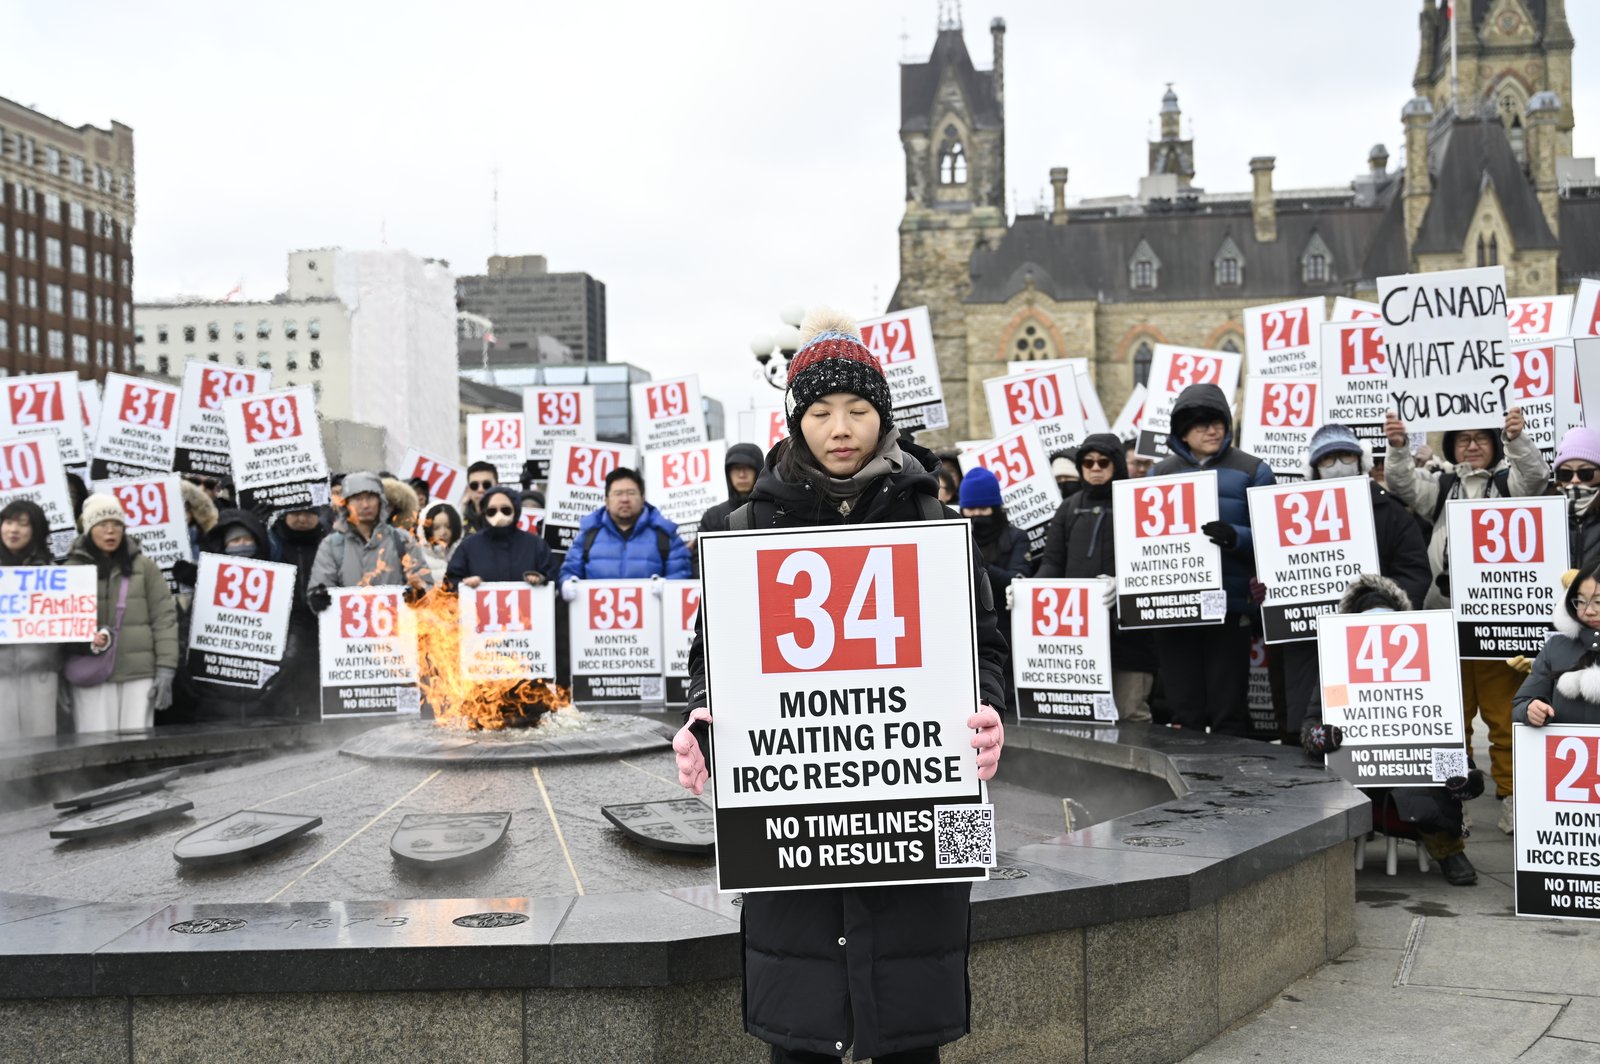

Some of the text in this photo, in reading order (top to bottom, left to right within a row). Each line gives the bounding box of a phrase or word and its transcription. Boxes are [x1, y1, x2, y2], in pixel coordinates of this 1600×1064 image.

[1382, 284, 1508, 326] CANADA
[1266, 311, 1304, 350] 27
[870, 321, 911, 365] 42
[1268, 352, 1306, 363] MONTHS
[1386, 340, 1505, 379] WHAT ARE
[1299, 361, 1317, 371] FOR
[908, 376, 926, 387] FOR
[1347, 380, 1387, 391] MONTH
[651, 383, 683, 417] 19
[1010, 377, 1057, 424] 30
[1336, 394, 1383, 405] WAITING
[1436, 374, 1509, 417] DOING?
[14, 382, 58, 424] 27
[125, 386, 167, 430] 31
[542, 393, 577, 425] 39
[1265, 384, 1311, 427] 39
[248, 398, 295, 441] 39
[1329, 408, 1353, 419] IRCC
[484, 420, 519, 448] 28
[1055, 434, 1074, 446] FOR
[1264, 433, 1307, 442] MONTHS
[254, 444, 298, 457] MONTHS
[1254, 444, 1298, 455] WAITING
[245, 456, 290, 470] WAITING
[291, 453, 311, 464] FOR
[571, 448, 615, 487] 30
[665, 449, 707, 487] 30
[570, 491, 605, 500] MONTH
[668, 488, 706, 499] MONTHS
[1030, 492, 1048, 507] FOR
[120, 482, 164, 527] 39
[1141, 483, 1190, 537] 31
[551, 512, 572, 521] IRCC
[1282, 489, 1344, 545] 34
[1478, 508, 1537, 563] 30
[160, 541, 178, 551] FOR
[1142, 542, 1191, 557] MONTHS
[1288, 549, 1345, 565] MONTHS
[1131, 556, 1205, 573] WAITING FOR
[14, 569, 67, 591] THE
[1125, 571, 1212, 588] IRCC RESPONSE
[1275, 564, 1362, 582] WAITING FOR
[1481, 571, 1537, 583] MONTHS
[220, 565, 268, 611] 39
[1269, 586, 1298, 599] IRCC
[1468, 587, 1553, 599] WAITING FOR
[1136, 593, 1200, 608] NO TIMELINES
[482, 590, 527, 631] 11
[593, 588, 639, 629] 35
[776, 547, 905, 670] 34
[1036, 588, 1084, 636] 34
[1141, 606, 1198, 620] NO RESULTS
[1284, 608, 1301, 620] NO
[1461, 603, 1556, 616] IRCC RESPONS
[217, 613, 262, 627] MONTHS
[345, 595, 393, 637] 36
[12, 616, 97, 639] TOGETHER
[205, 624, 272, 641] WAITING FOR
[1290, 621, 1307, 632] NO
[1475, 626, 1490, 637] NO
[196, 635, 277, 655] IRCC RESPONSE
[595, 635, 637, 645] MONTHS
[1480, 640, 1495, 650] NO
[346, 643, 393, 654] MONTHS
[520, 650, 541, 660] FOR
[584, 647, 649, 657] WAITING FOR
[1038, 644, 1083, 655] MONTHS
[1355, 624, 1422, 682] 42
[204, 653, 218, 665] NO
[335, 656, 381, 667] WAITING
[578, 659, 656, 670] IRCC RESPONSE
[1027, 659, 1096, 670] WAITING FOR
[206, 665, 220, 675] NO
[328, 668, 412, 681] IRCC RESPONSE
[588, 677, 602, 686] NO
[1022, 672, 1103, 685] IRCC RESPONSE
[339, 689, 353, 699] NO
[592, 686, 605, 696] NO
[1033, 692, 1093, 704] NO TIMELINES
[1359, 688, 1424, 702] MONTHS
[343, 700, 356, 709] NO
[779, 686, 907, 718] MONTHS
[1038, 703, 1091, 716] NO RESULTS
[1343, 705, 1442, 720] WAITING FOR
[1371, 723, 1453, 737] RESPONSE
[749, 721, 942, 756] WAITING FOR
[1351, 748, 1431, 762] NO TIMELINE
[733, 756, 962, 793] IRCC RESPONSE
[1358, 765, 1378, 776] NO
[766, 810, 934, 840] NO TIMELINES
[1537, 830, 1600, 847] WAITIN
[778, 840, 924, 869] NO RESULTS
[1527, 849, 1564, 865] IRCC
[1544, 878, 1565, 892] NO
[1551, 894, 1571, 908] NO
